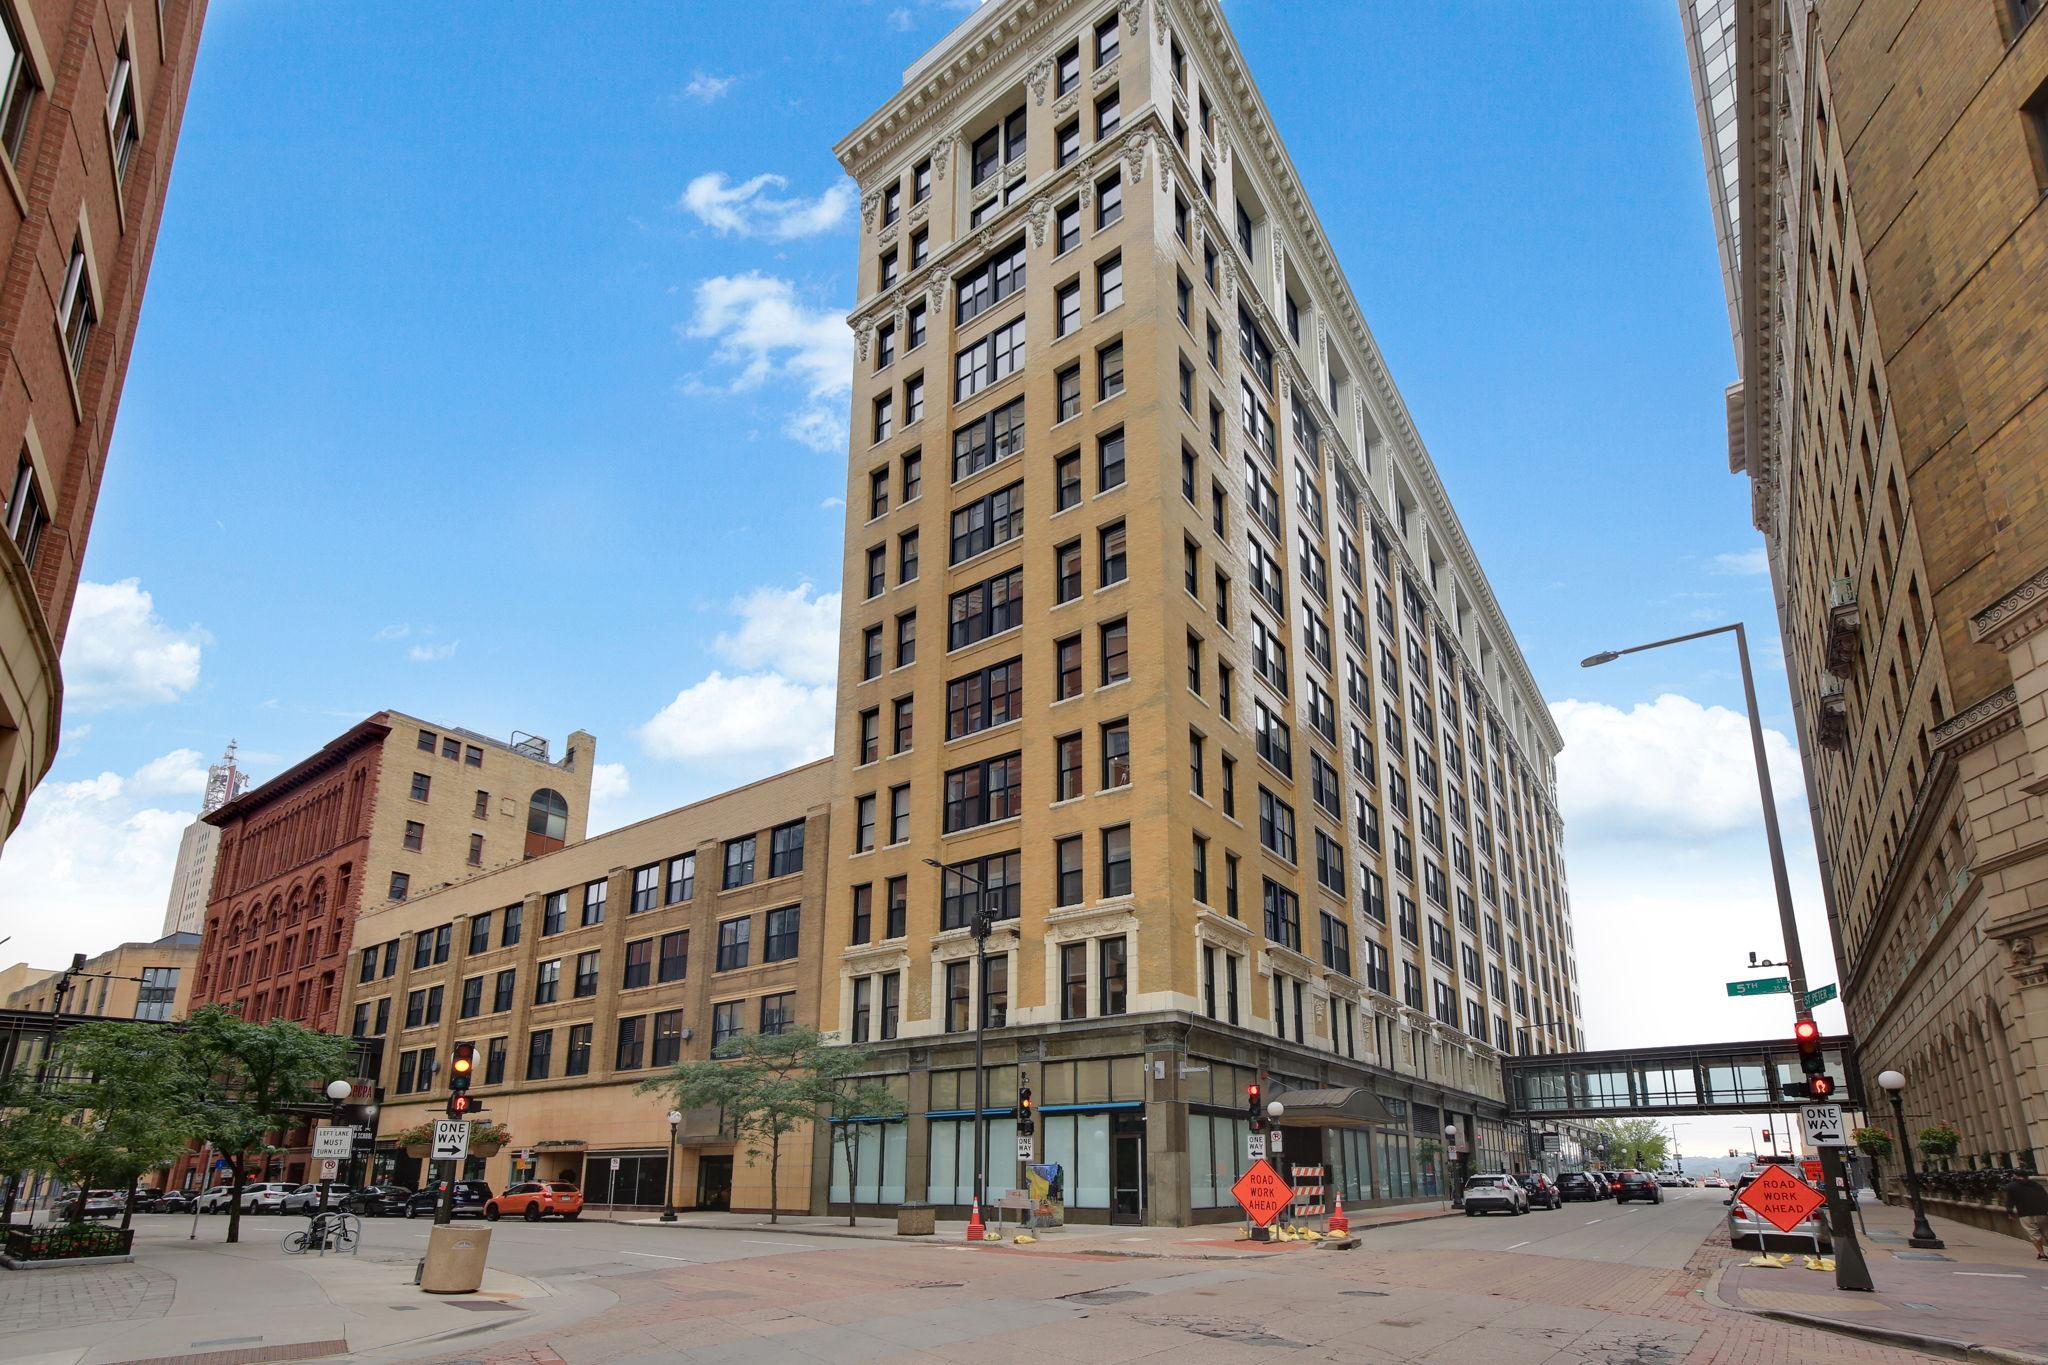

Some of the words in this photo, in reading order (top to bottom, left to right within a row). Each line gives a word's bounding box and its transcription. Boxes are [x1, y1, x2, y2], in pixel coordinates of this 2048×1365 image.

[1736, 983, 1758, 993] 5TH
[1812, 989, 1828, 1001] PETER
[349, 1085, 372, 1098] PCPA
[1806, 1108, 1837, 1118] ONE
[440, 1123, 465, 1132] ONE
[1807, 1120, 1838, 1129] WAY
[438, 1134, 465, 1143] WAY
[1250, 1175, 1273, 1185] ROAD
[1763, 1180, 1795, 1189] ROAD
[1250, 1187, 1275, 1197] WORK
[1764, 1192, 1797, 1200] WORK
[1249, 1200, 1277, 1211] AHEAD
[1764, 1205, 1804, 1213] AHEAD
